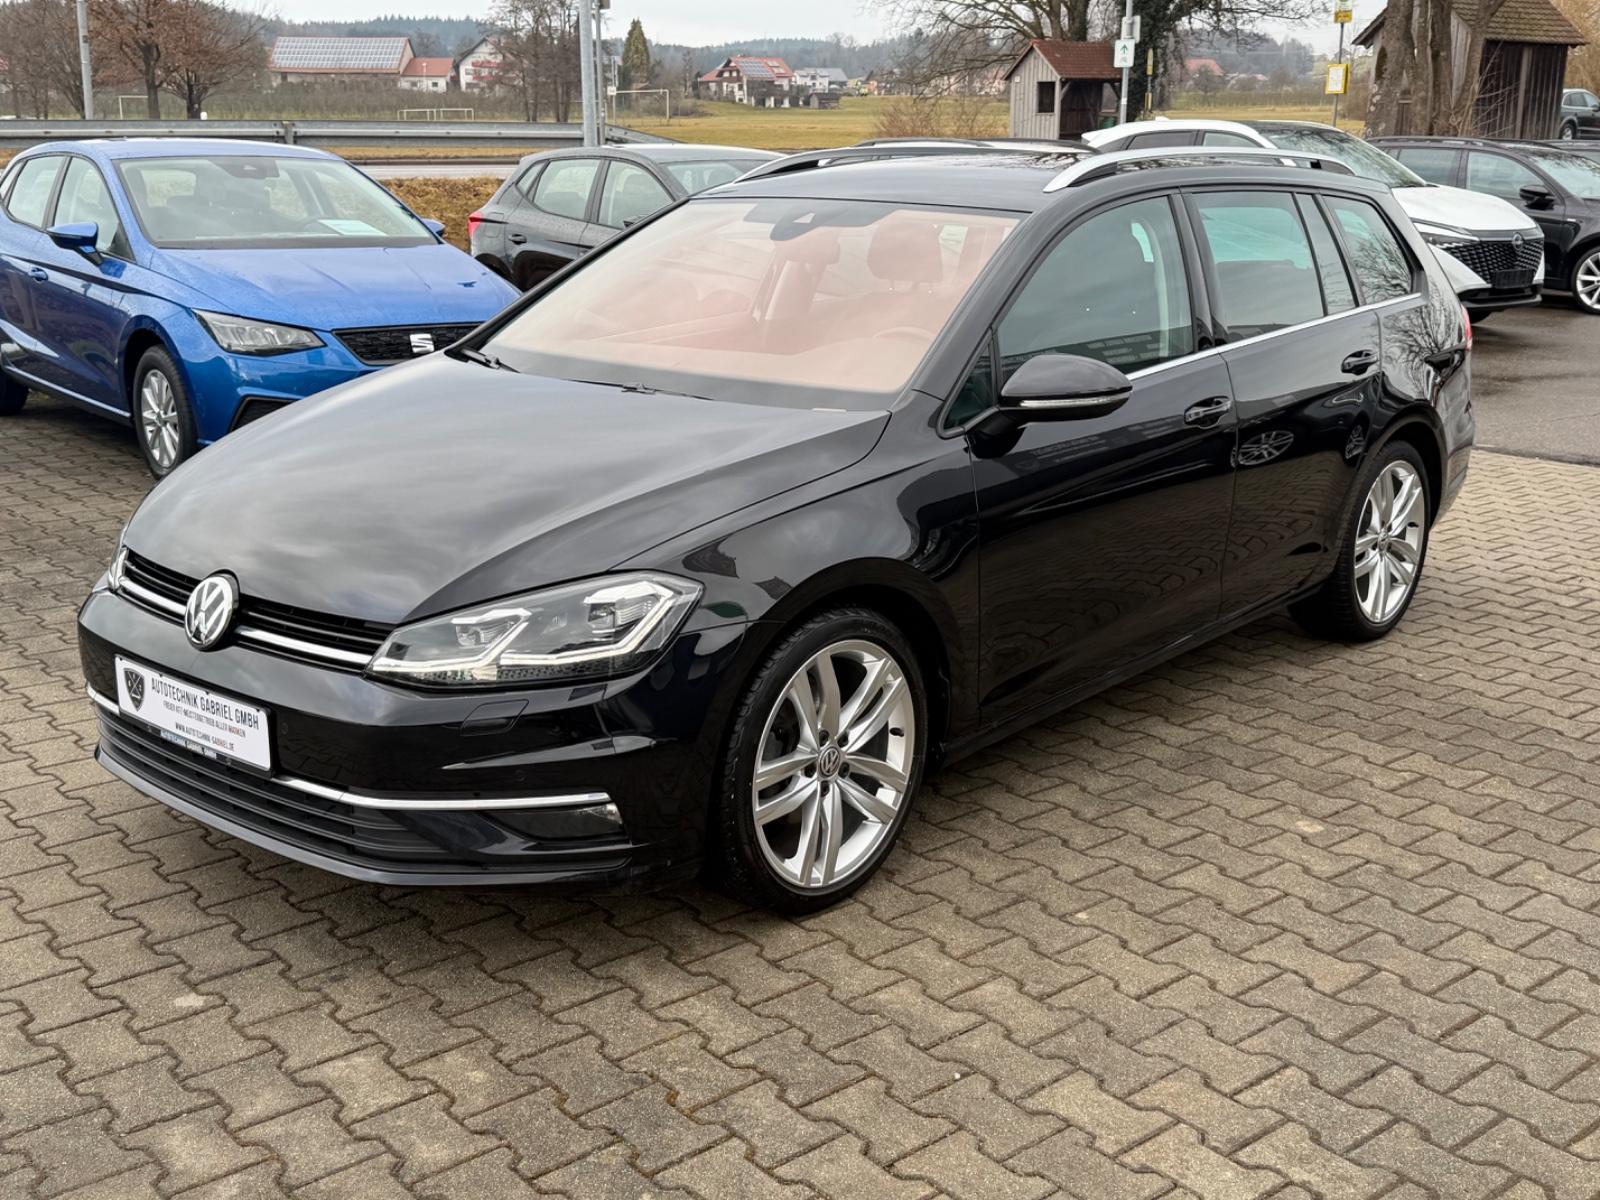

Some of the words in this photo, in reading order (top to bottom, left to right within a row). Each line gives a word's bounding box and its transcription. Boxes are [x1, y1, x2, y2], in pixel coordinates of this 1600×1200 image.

[152, 677, 199, 709] AUTOTECHNIK
[200, 696, 233, 722] GABRIEL
[234, 708, 259, 730] GMBH
